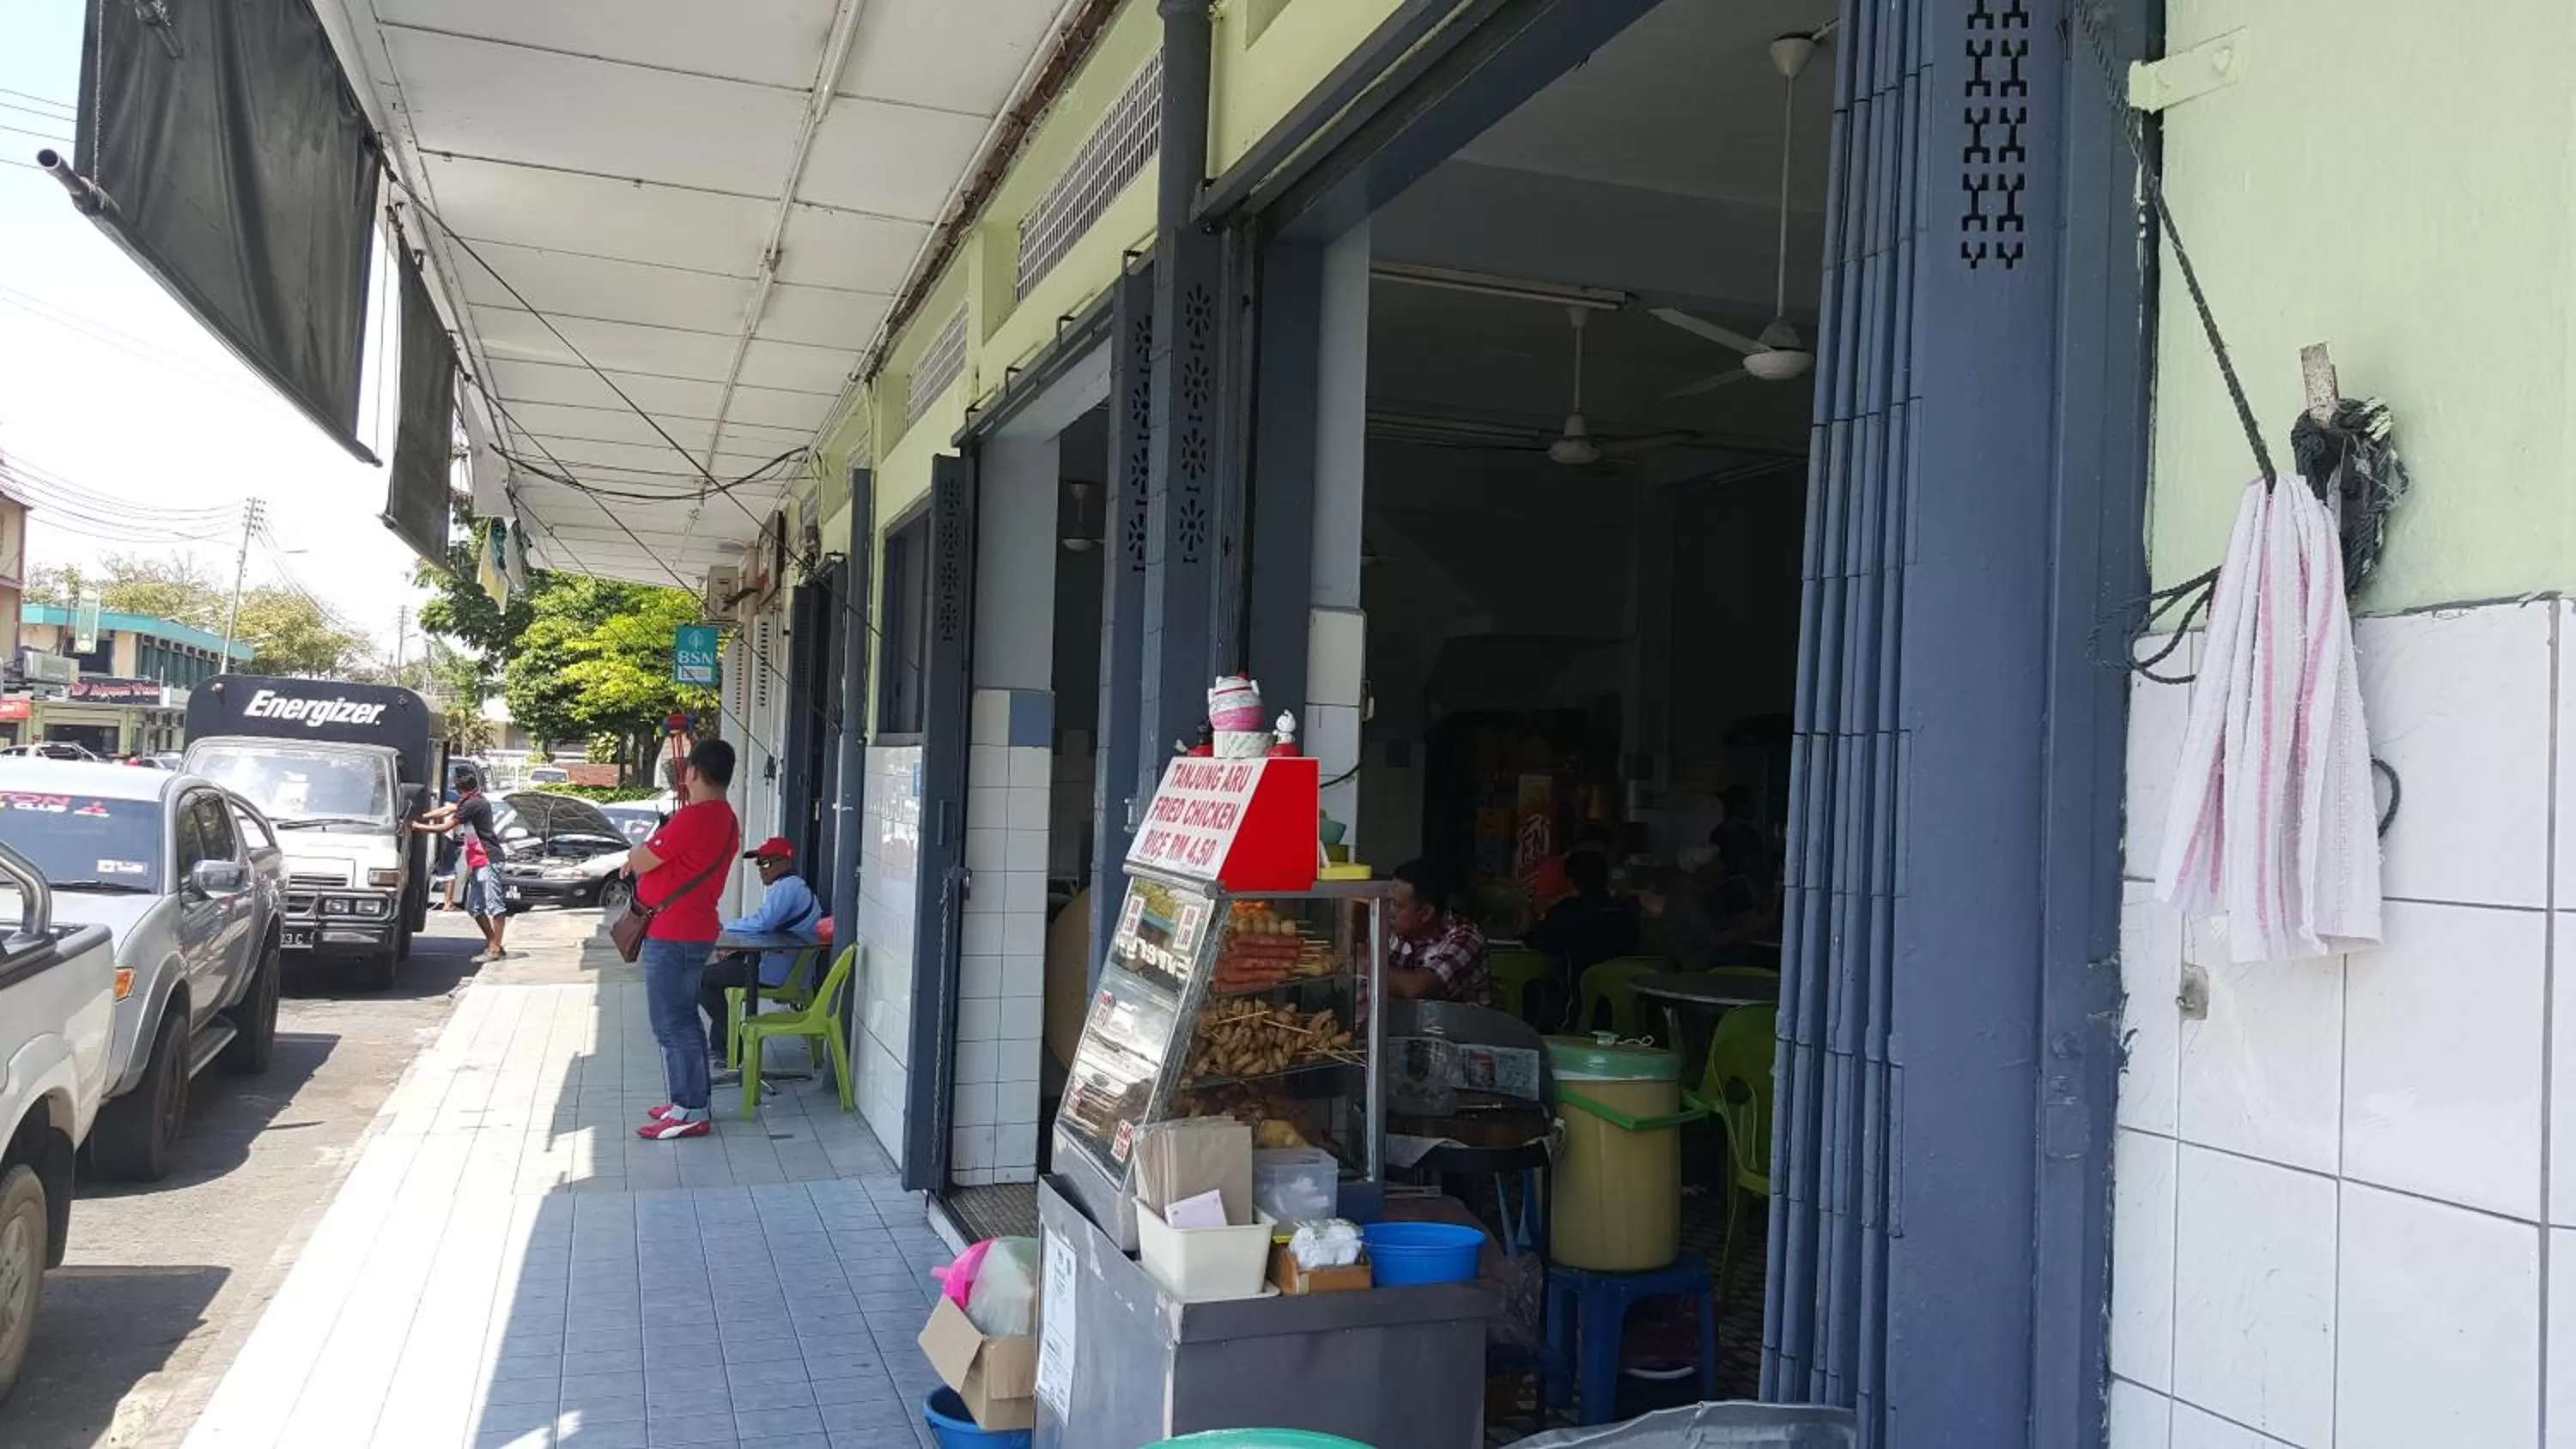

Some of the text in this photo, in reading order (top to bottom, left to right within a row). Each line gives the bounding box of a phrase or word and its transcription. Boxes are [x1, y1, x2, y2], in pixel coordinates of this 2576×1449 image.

[678, 650, 713, 664] BSN
[1170, 763, 1254, 793] TANJUNG ARU
[1151, 797, 1240, 831] FRIED CHICKEN
[1140, 830, 1218, 866] RICE RM 4.50
